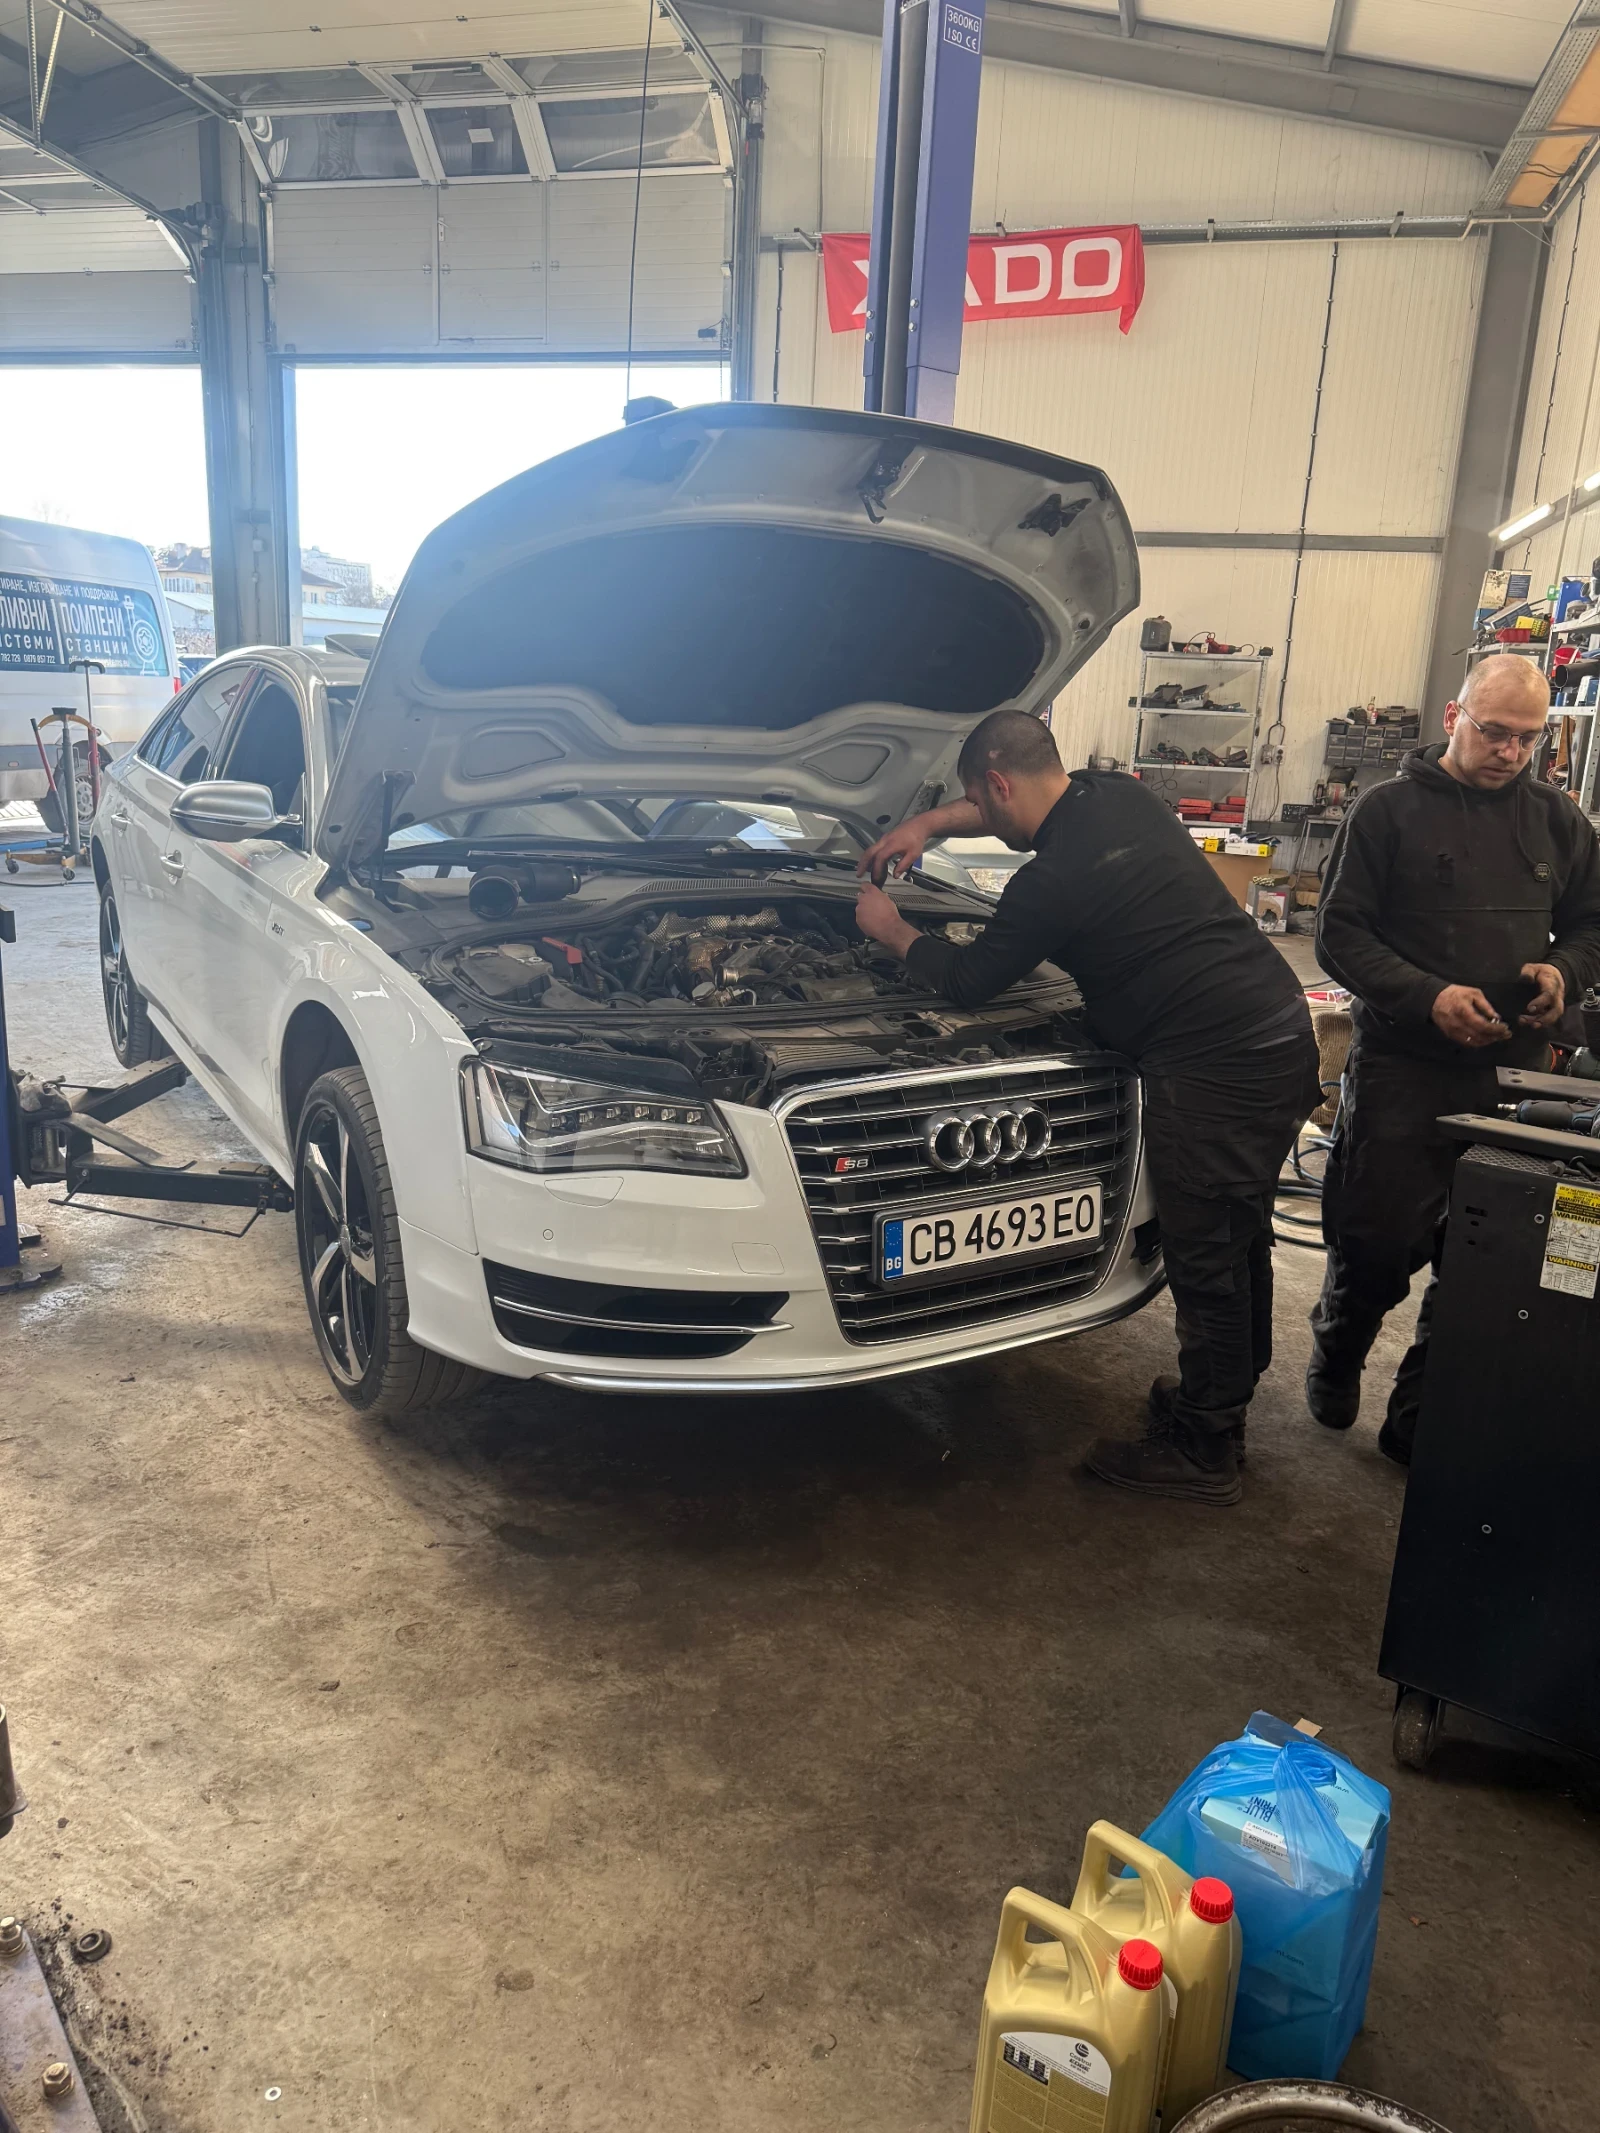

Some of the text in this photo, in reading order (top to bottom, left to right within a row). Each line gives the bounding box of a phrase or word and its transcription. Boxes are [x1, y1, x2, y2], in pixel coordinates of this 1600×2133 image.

[948, 10, 980, 33] 3600KG
[947, 27, 963, 44] ISO
[852, 237, 1122, 316] DO
[59, 602, 126, 637] ПОМПЕНИ
[66, 637, 129, 656] станции
[843, 1158, 869, 1169] S8
[910, 1194, 1095, 1265] CB 4693 EO
[886, 1256, 902, 1272] BG
[1548, 1255, 1595, 1271] WARNING
[1069, 2052, 1092, 2067] Castrol
[1069, 2058, 1091, 2073] EDGE
